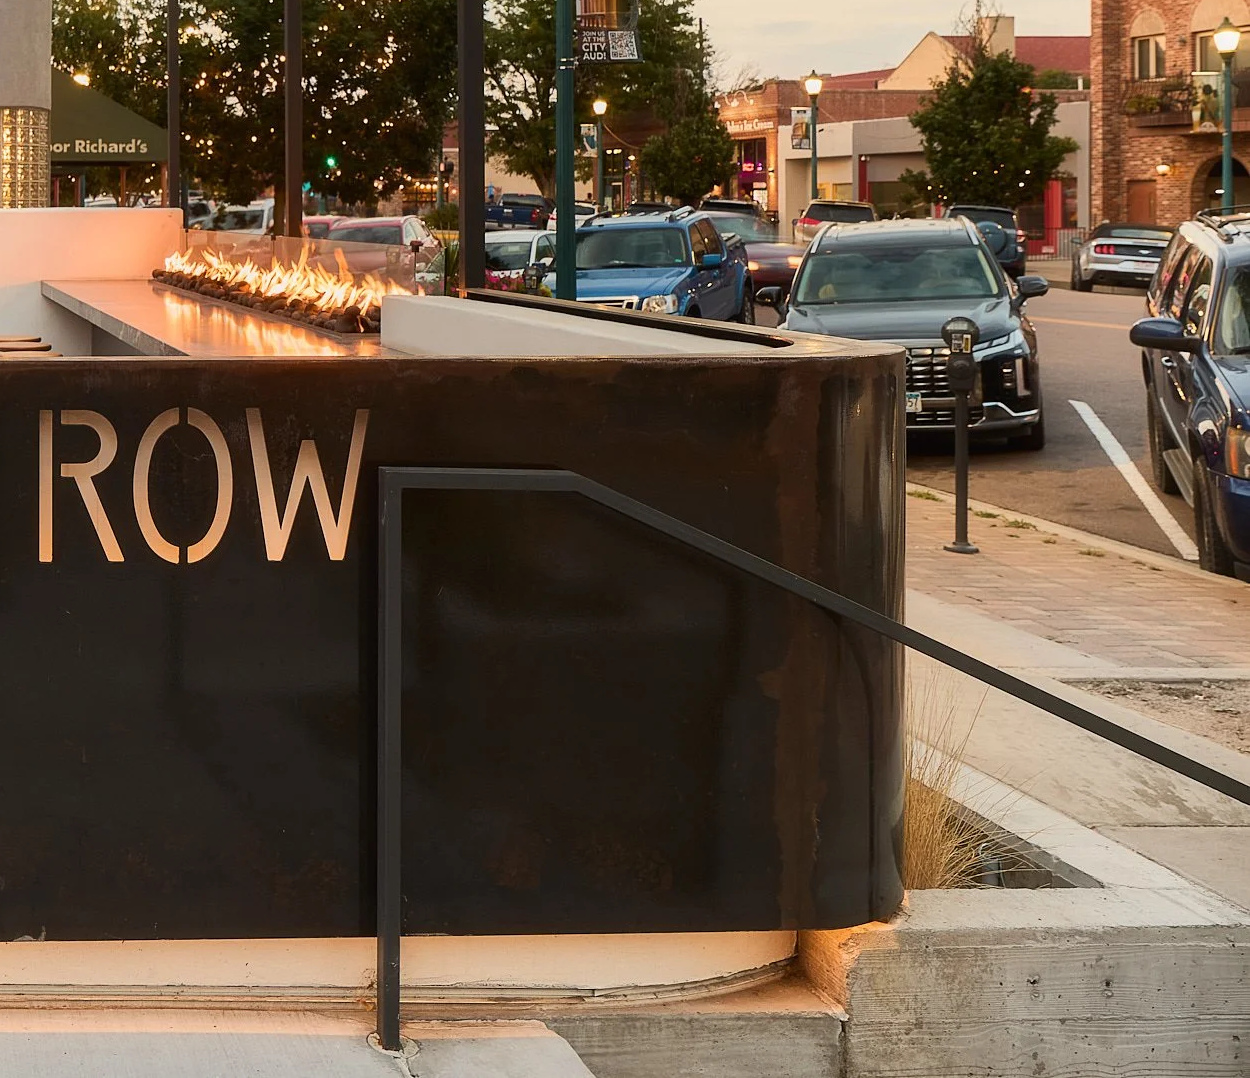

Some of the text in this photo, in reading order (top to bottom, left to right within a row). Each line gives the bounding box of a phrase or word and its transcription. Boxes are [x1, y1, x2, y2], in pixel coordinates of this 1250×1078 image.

[582, 42, 607, 52] CITY
[583, 52, 607, 61] AUD!
[75, 138, 148, 154] Richard's
[38, 406, 369, 563] ROW
